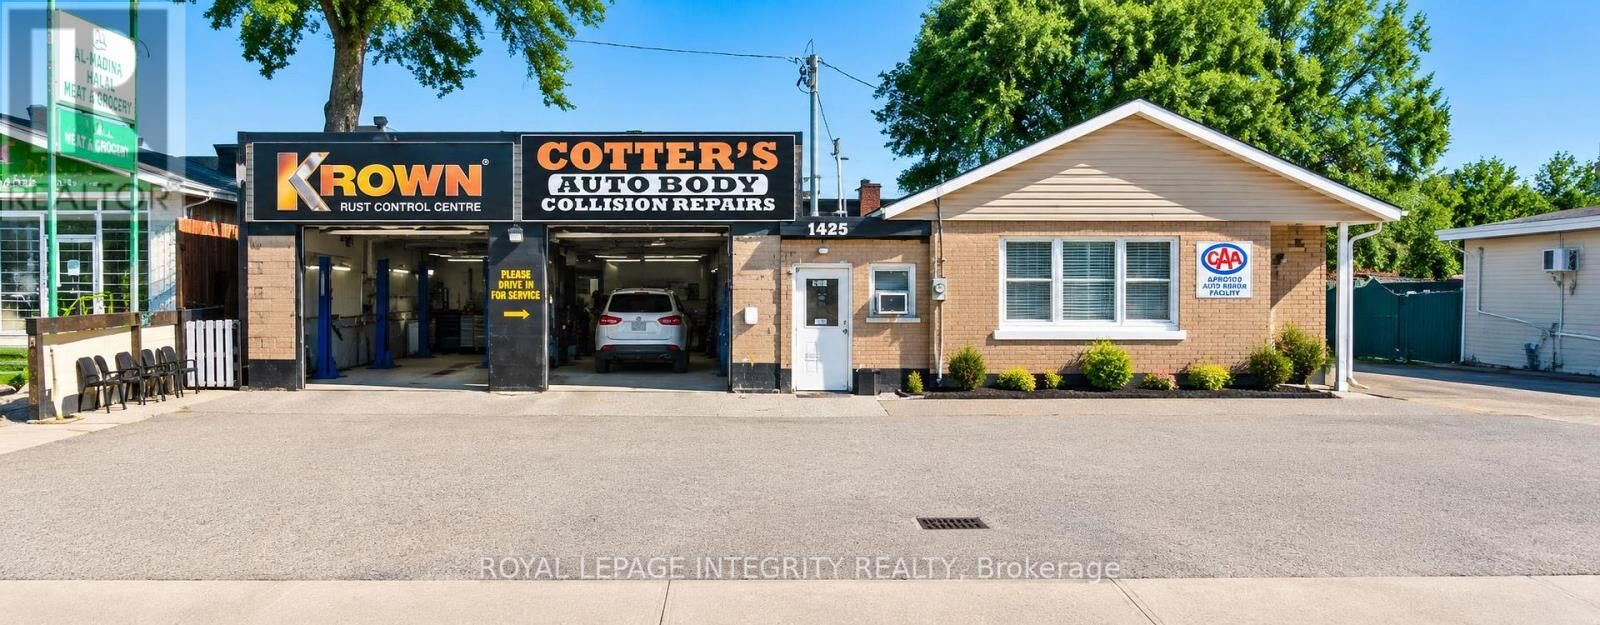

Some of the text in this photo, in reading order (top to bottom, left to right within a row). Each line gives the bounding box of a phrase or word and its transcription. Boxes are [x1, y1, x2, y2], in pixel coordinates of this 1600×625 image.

[86, 70, 116, 92] HALAL
[63, 80, 86, 101] MEAT
[97, 91, 132, 115] GROCERY
[537, 141, 779, 171] COTTER'S
[557, 176, 759, 193] AUTO BODY
[340, 202, 481, 212] RUST CONTROL CENTRE
[541, 197, 776, 212] COLLISION REPAIRS
[808, 222, 848, 236] 1425
[1207, 248, 1242, 269] CAA
[501, 269, 531, 279] PLEASE
[498, 280, 534, 289] DRIVE IN
[491, 290, 541, 300] FOR SERVICE
